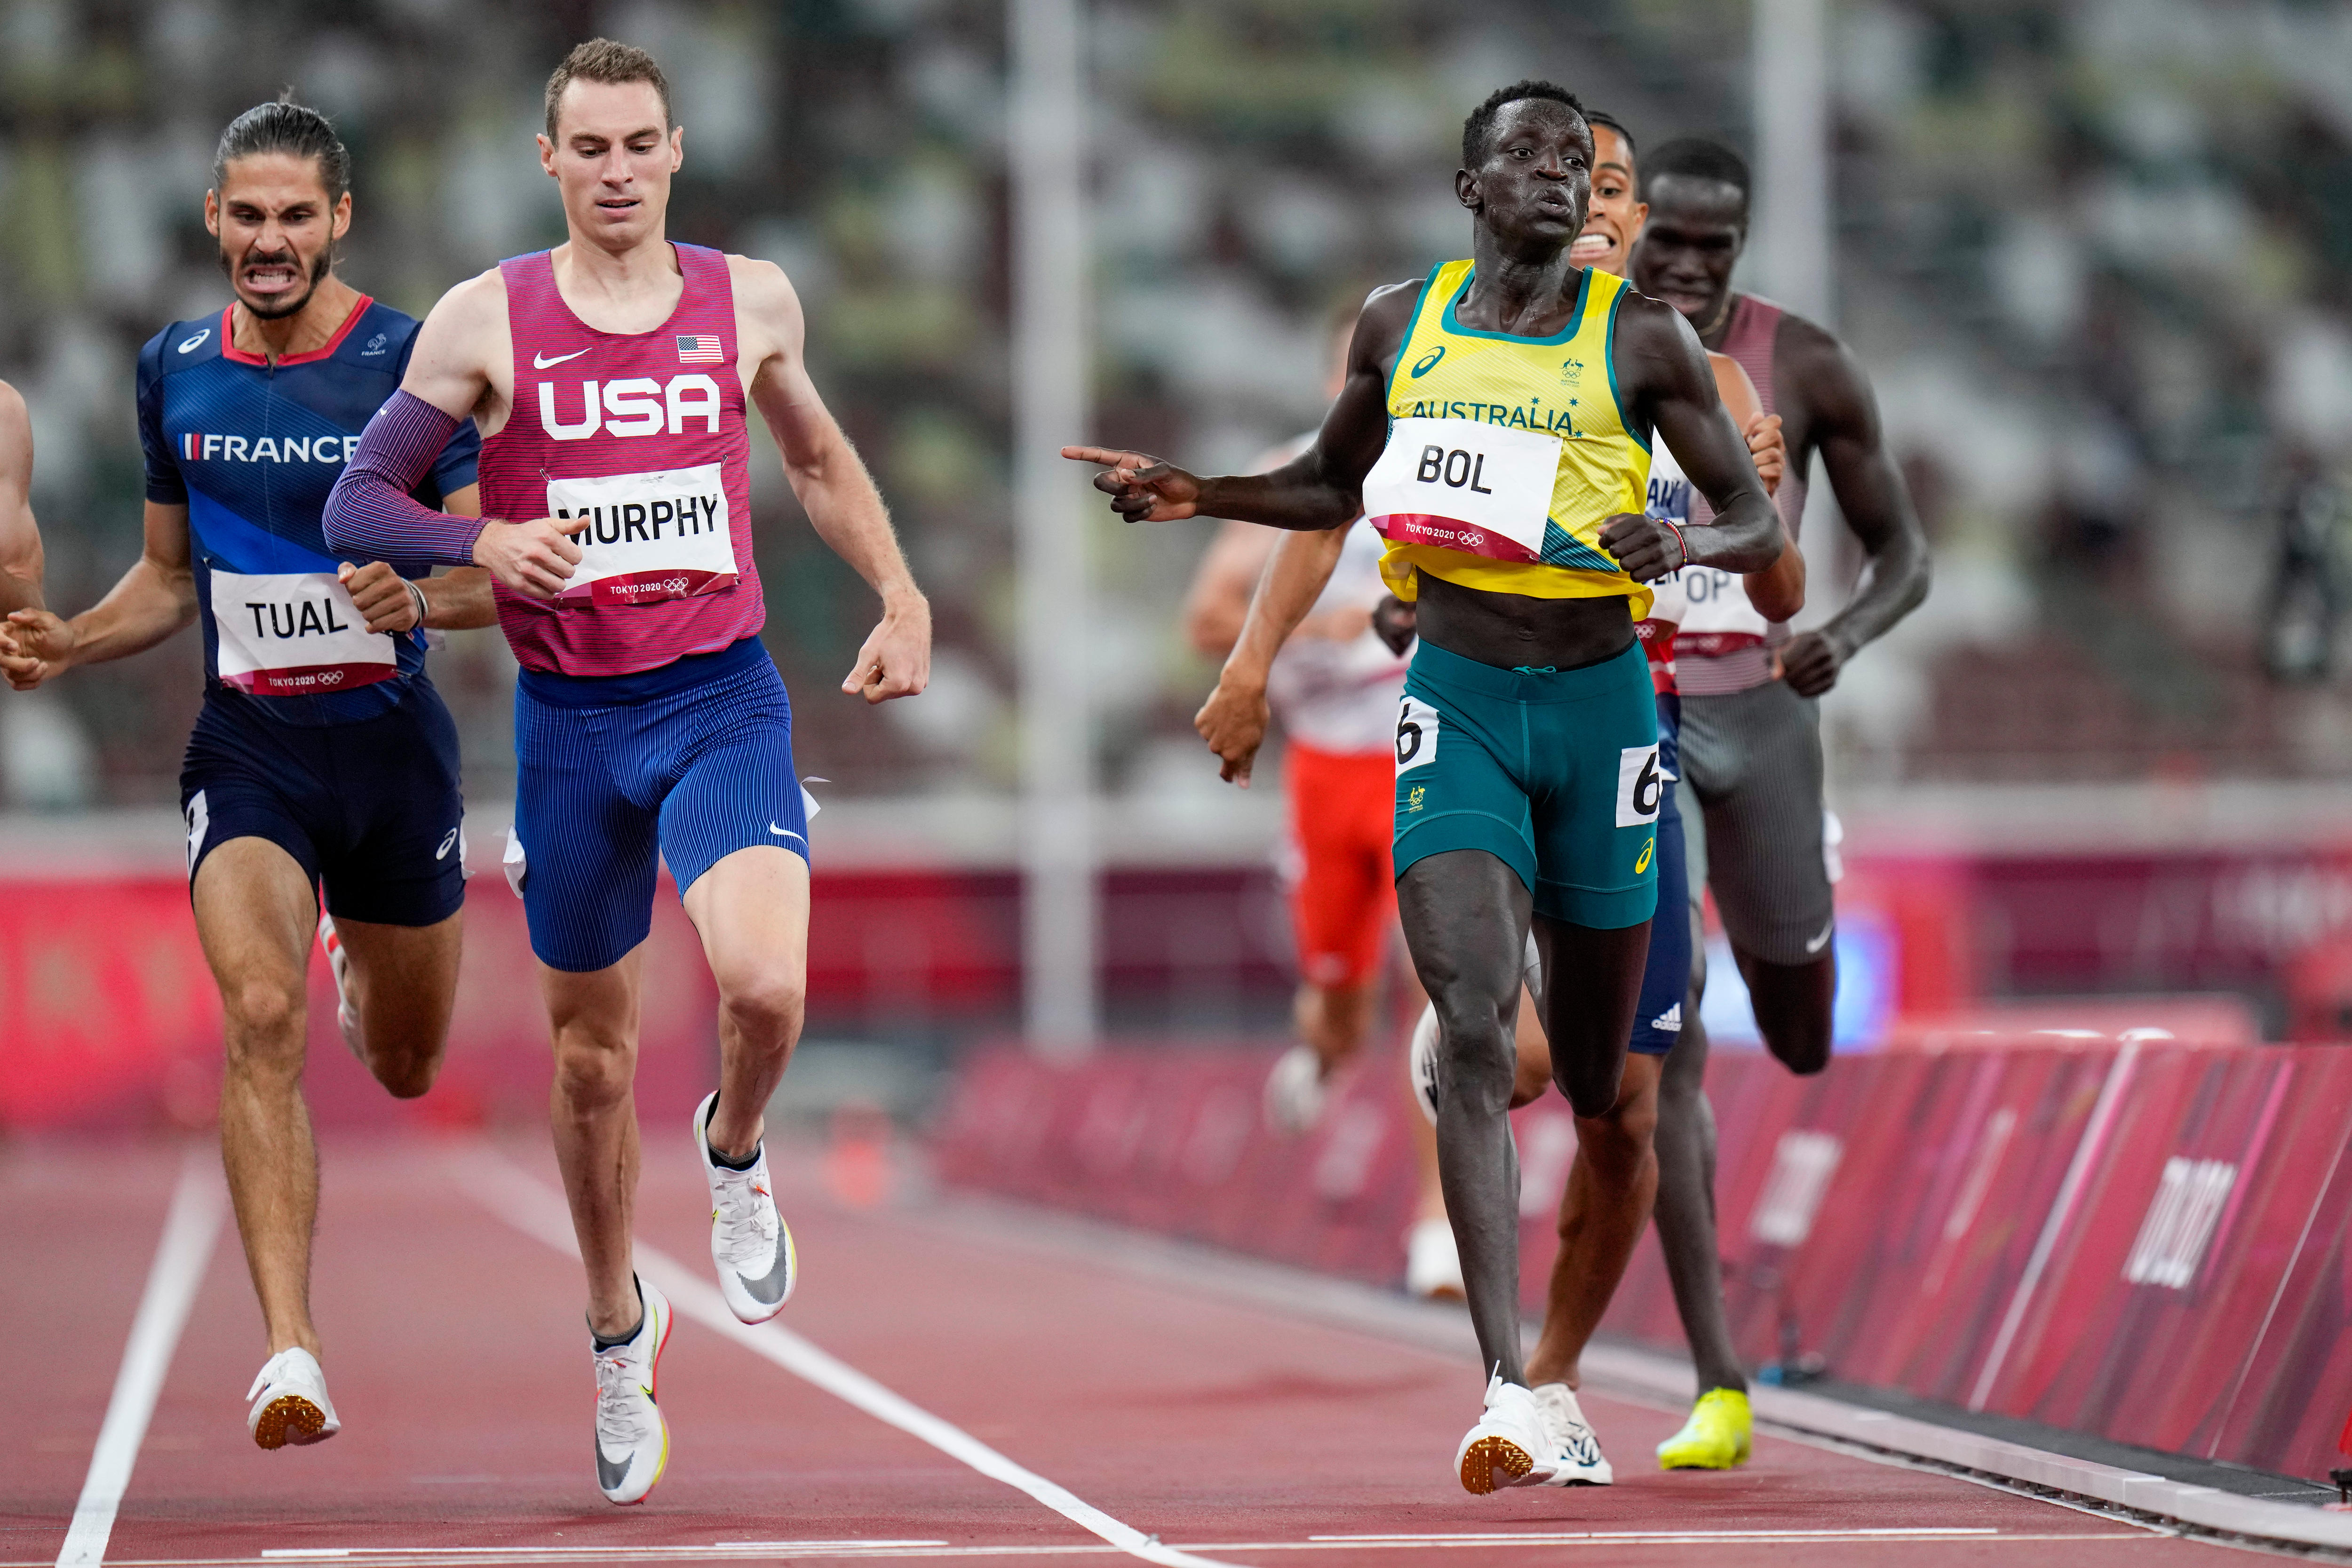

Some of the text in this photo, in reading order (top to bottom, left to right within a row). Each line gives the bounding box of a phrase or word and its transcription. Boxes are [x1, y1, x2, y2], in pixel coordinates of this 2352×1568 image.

[539, 374, 721, 441] USA
[1413, 401, 1573, 436] AUSTRALIA
[203, 434, 361, 463] FRANCE
[1417, 445, 1492, 494] BOL
[558, 493, 717, 546] MURPHY
[1406, 523, 1454, 540] TOKYO 2020
[610, 583, 660, 594] TOKYO 2020
[245, 597, 349, 639] TUAL
[268, 676, 315, 687] TOKYO 2020
[1396, 703, 1422, 764] 6
[1633, 751, 1660, 815] 6
